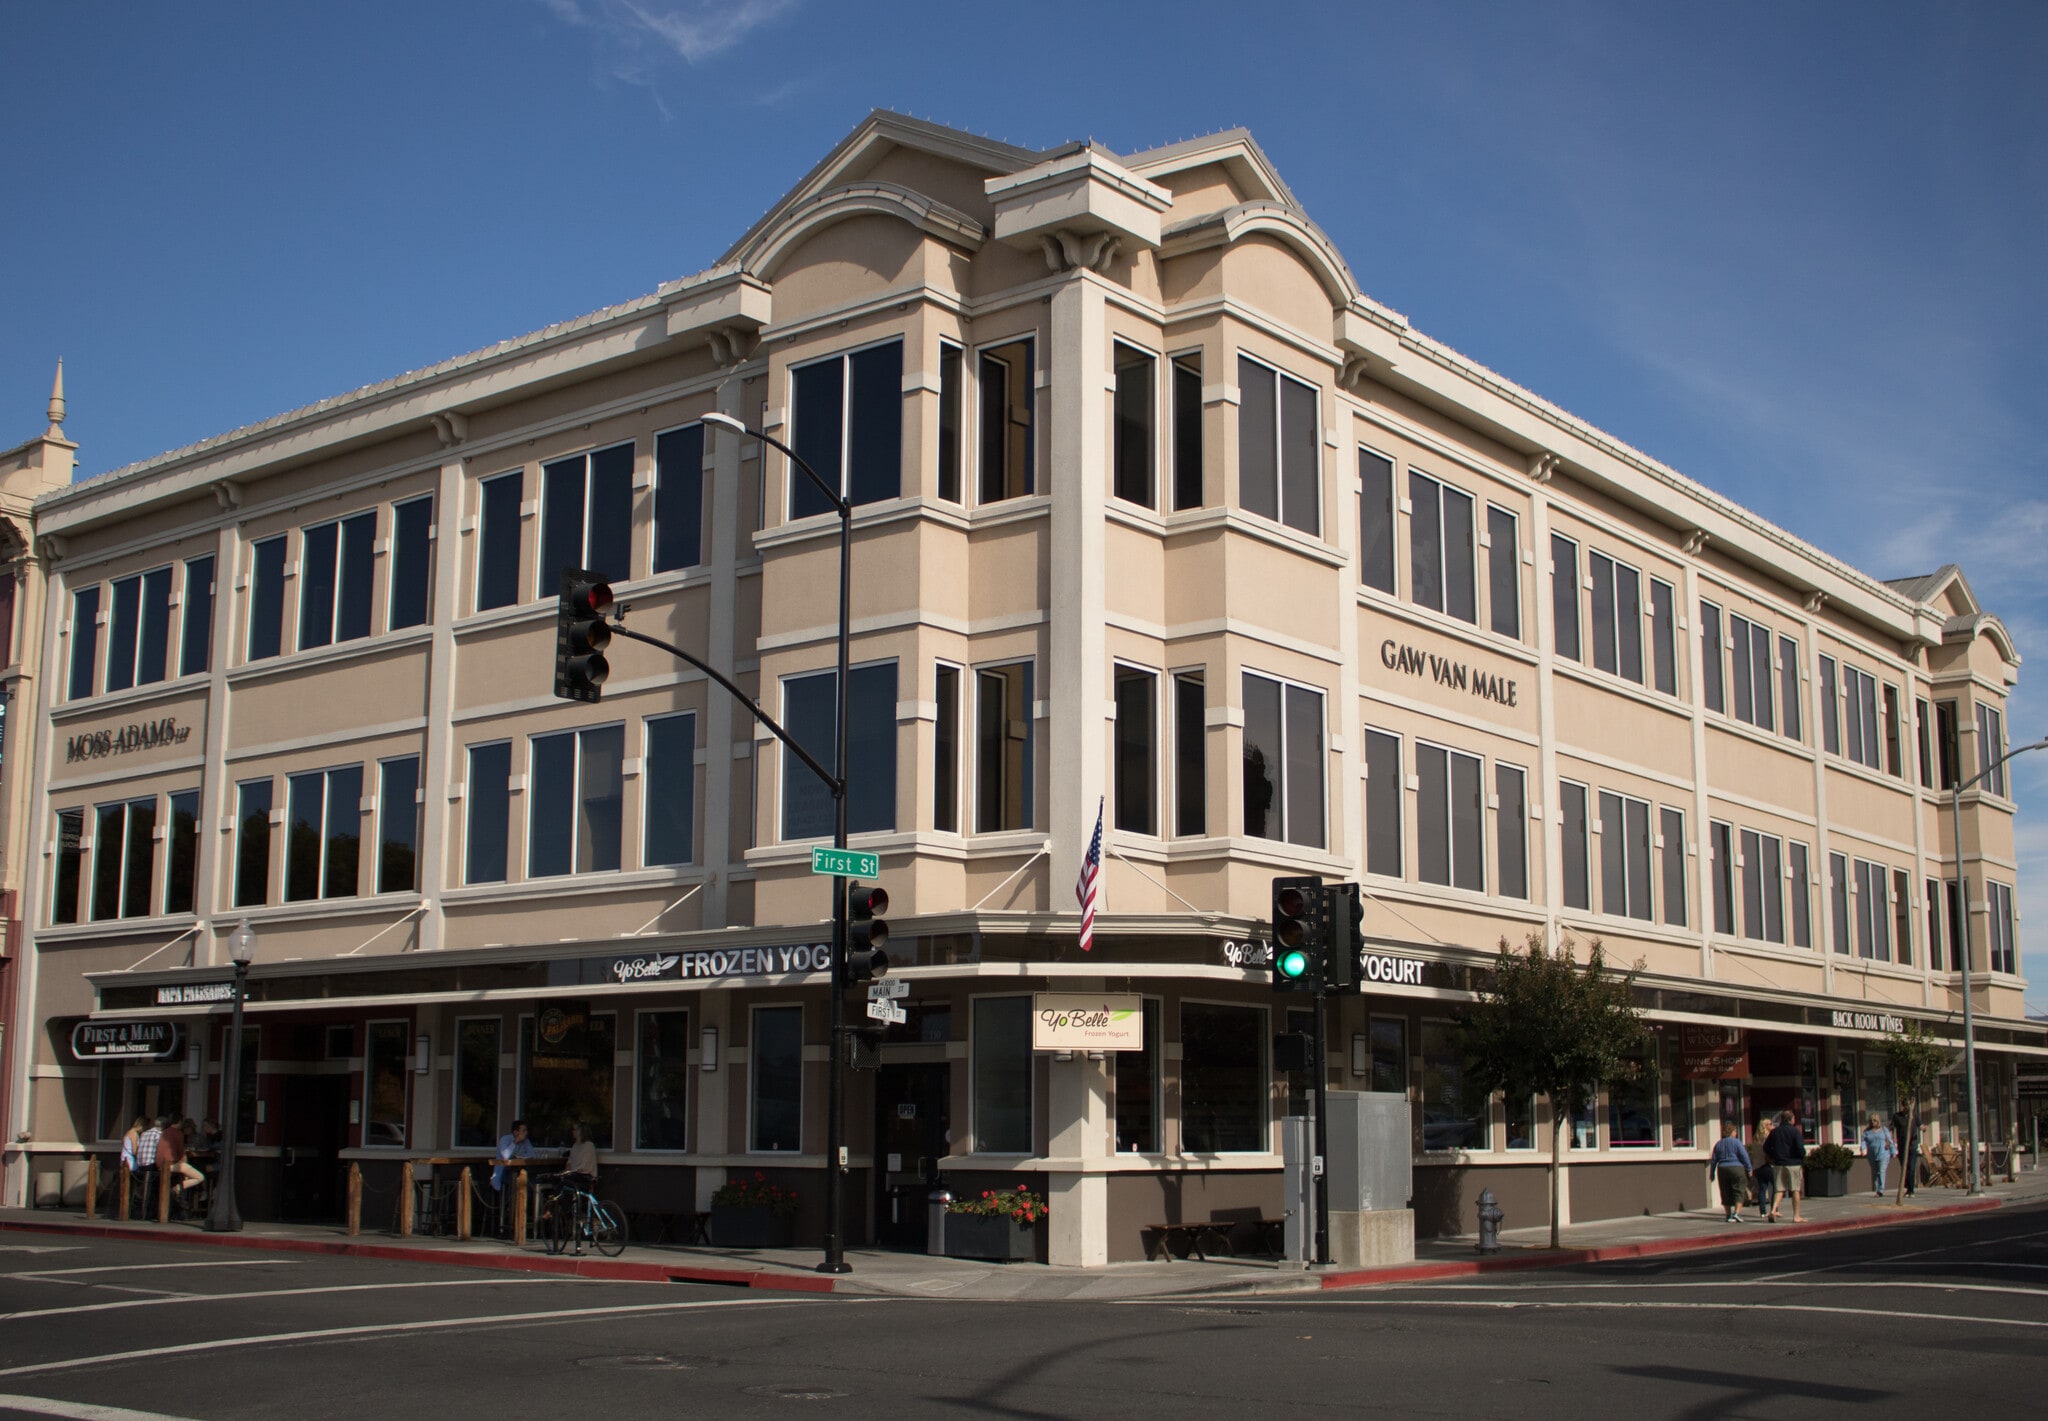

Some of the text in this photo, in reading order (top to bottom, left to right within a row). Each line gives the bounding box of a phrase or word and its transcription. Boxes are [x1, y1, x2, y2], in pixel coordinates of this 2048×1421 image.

[1381, 639, 1517, 708] GAW VAN MALE
[67, 730, 112, 760] MOSS
[113, 717, 176, 750] ADAMS
[815, 852, 875, 875] First St
[682, 948, 773, 978] FROZEN
[872, 986, 891, 997] MAIN
[872, 1005, 890, 1018] FIRST
[1832, 1010, 1904, 1033] BACK ROOM WINES
[83, 1024, 164, 1043] FIRST & MAIN
[1108, 1030, 1129, 1038] Yogurt
[1683, 1055, 1743, 1066] WINE SHOP
